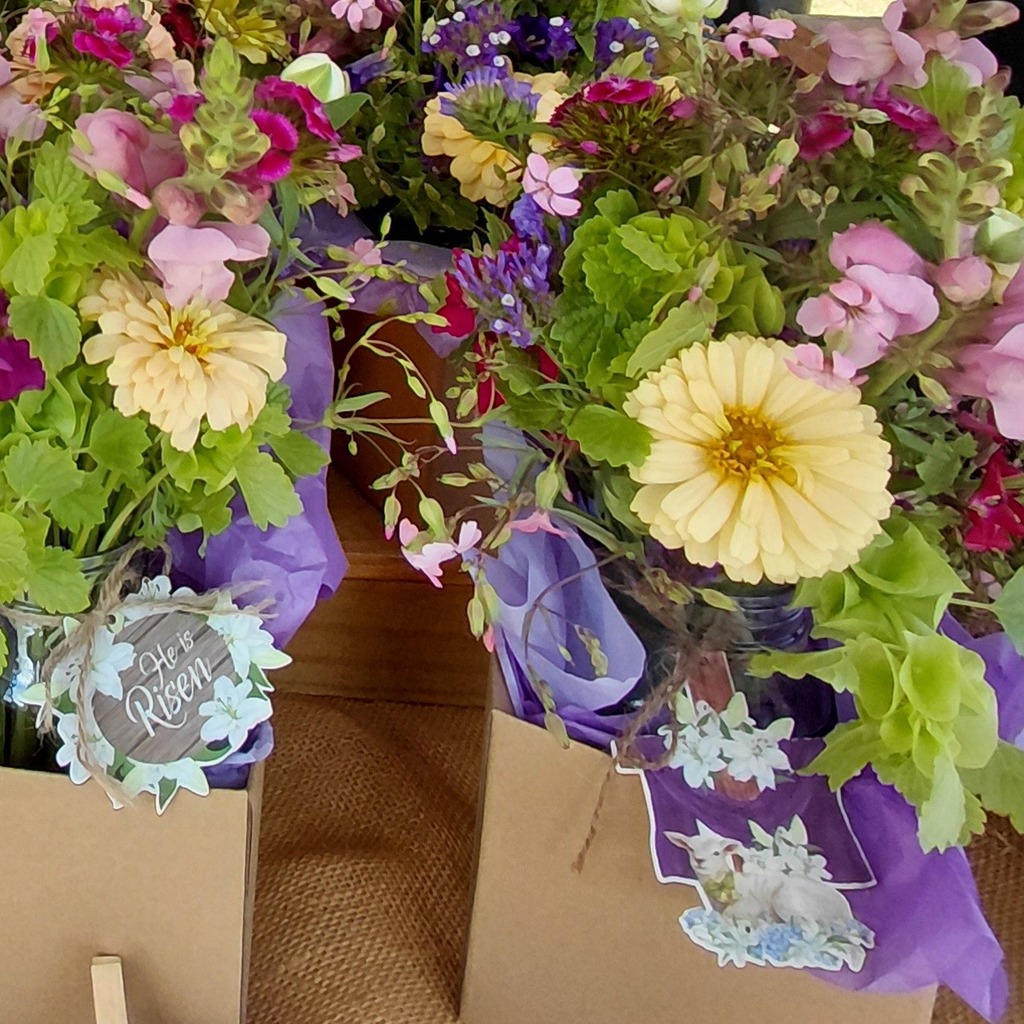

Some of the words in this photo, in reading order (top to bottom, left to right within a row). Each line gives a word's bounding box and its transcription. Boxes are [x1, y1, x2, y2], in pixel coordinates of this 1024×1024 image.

[139, 643, 178, 688] He
[176, 629, 194, 652] is
[126, 657, 212, 737] Risen
